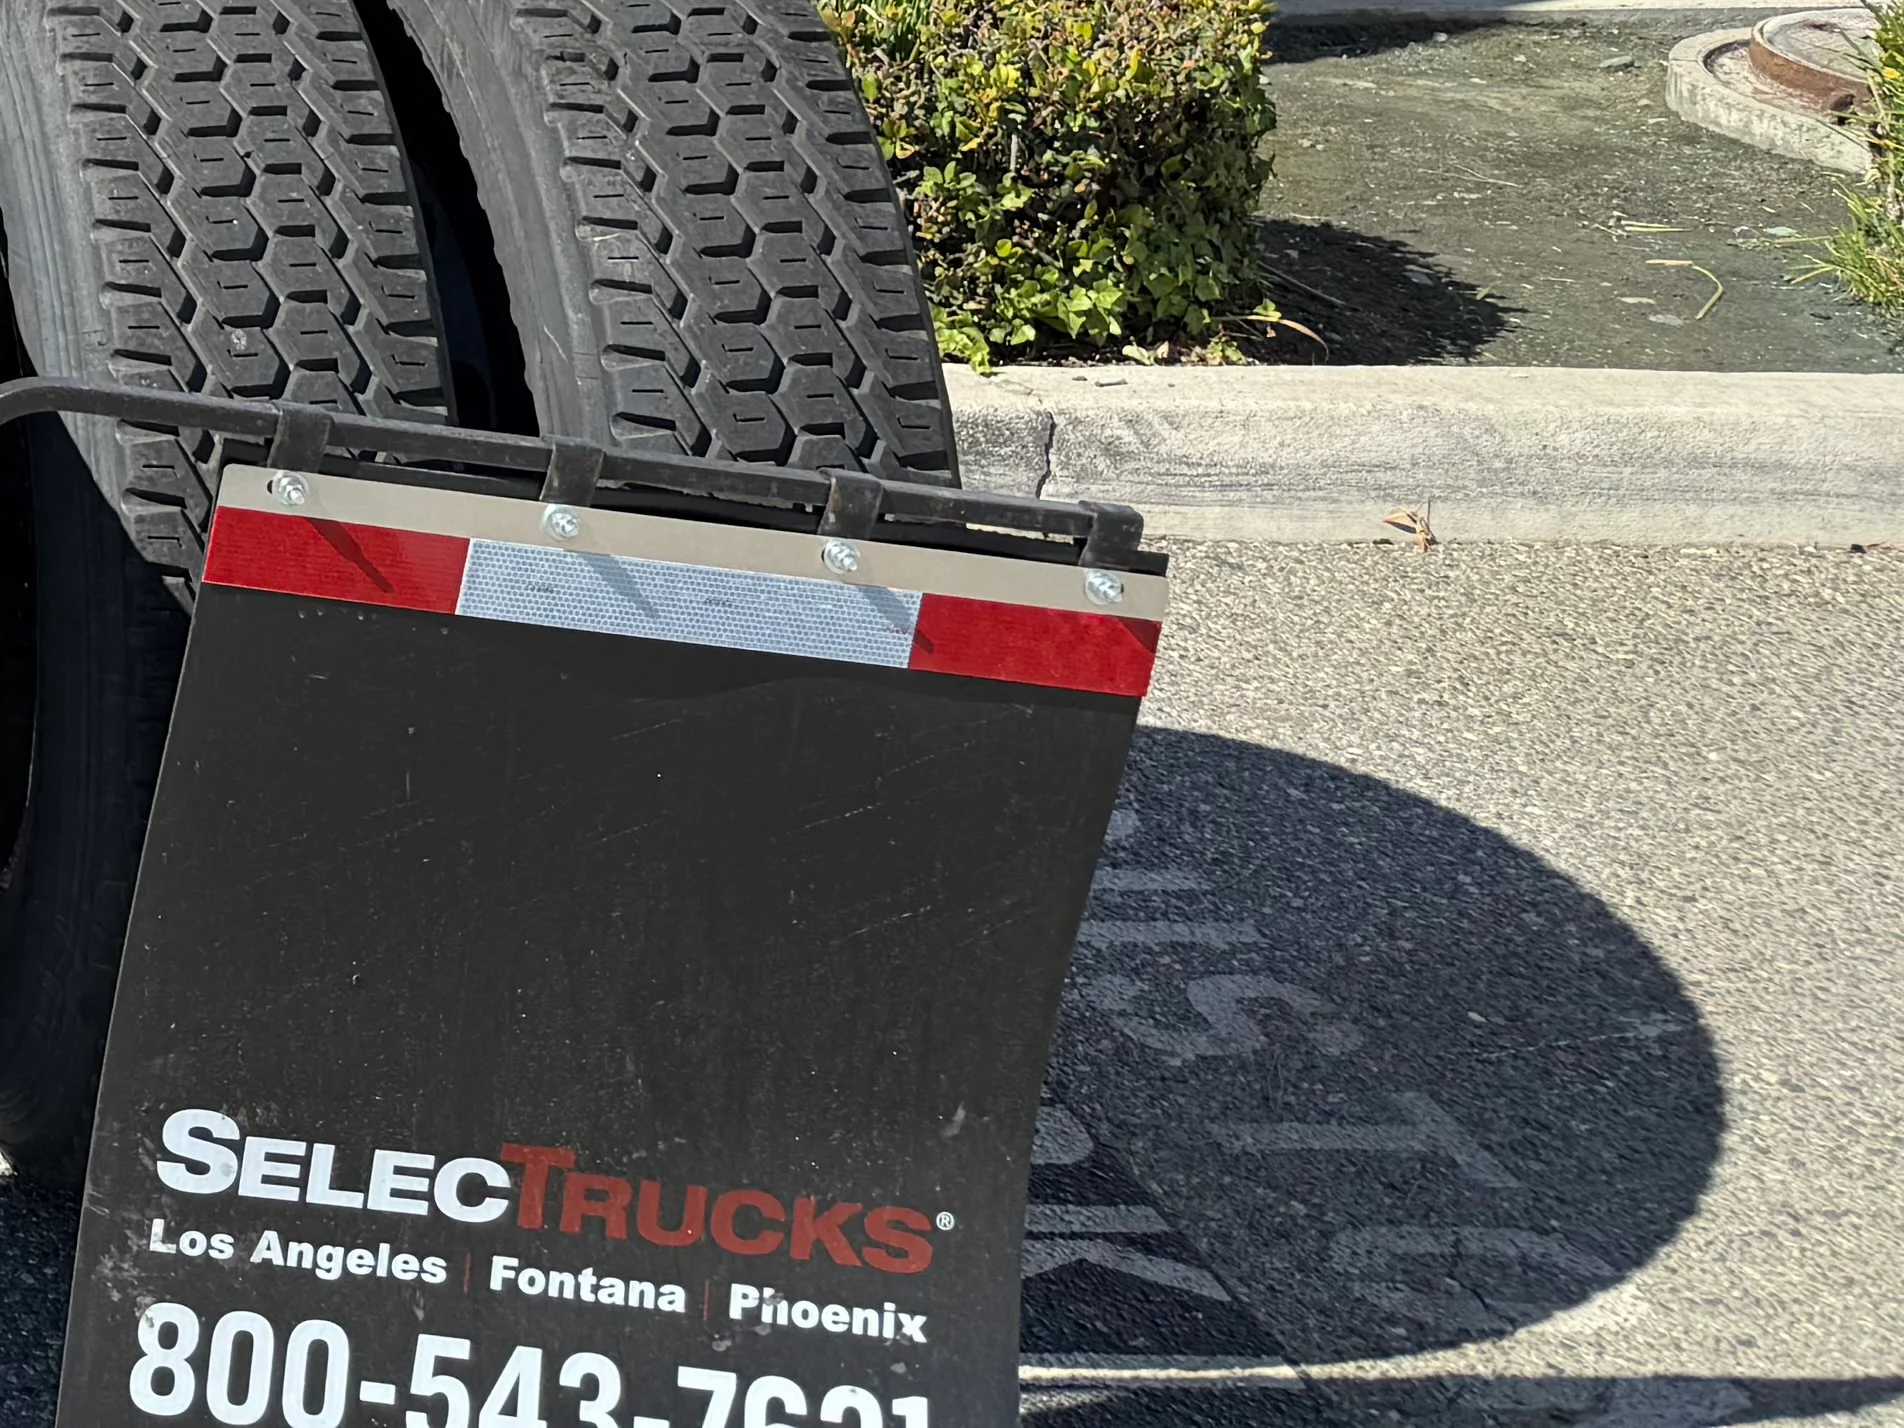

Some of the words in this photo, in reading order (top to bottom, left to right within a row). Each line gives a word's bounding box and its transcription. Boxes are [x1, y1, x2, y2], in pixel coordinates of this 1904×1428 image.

[149, 1217, 234, 1260] Los
[250, 1230, 447, 1284] Angeles
[490, 1255, 686, 1314] Fontana
[729, 1283, 927, 1346] Phoenix
